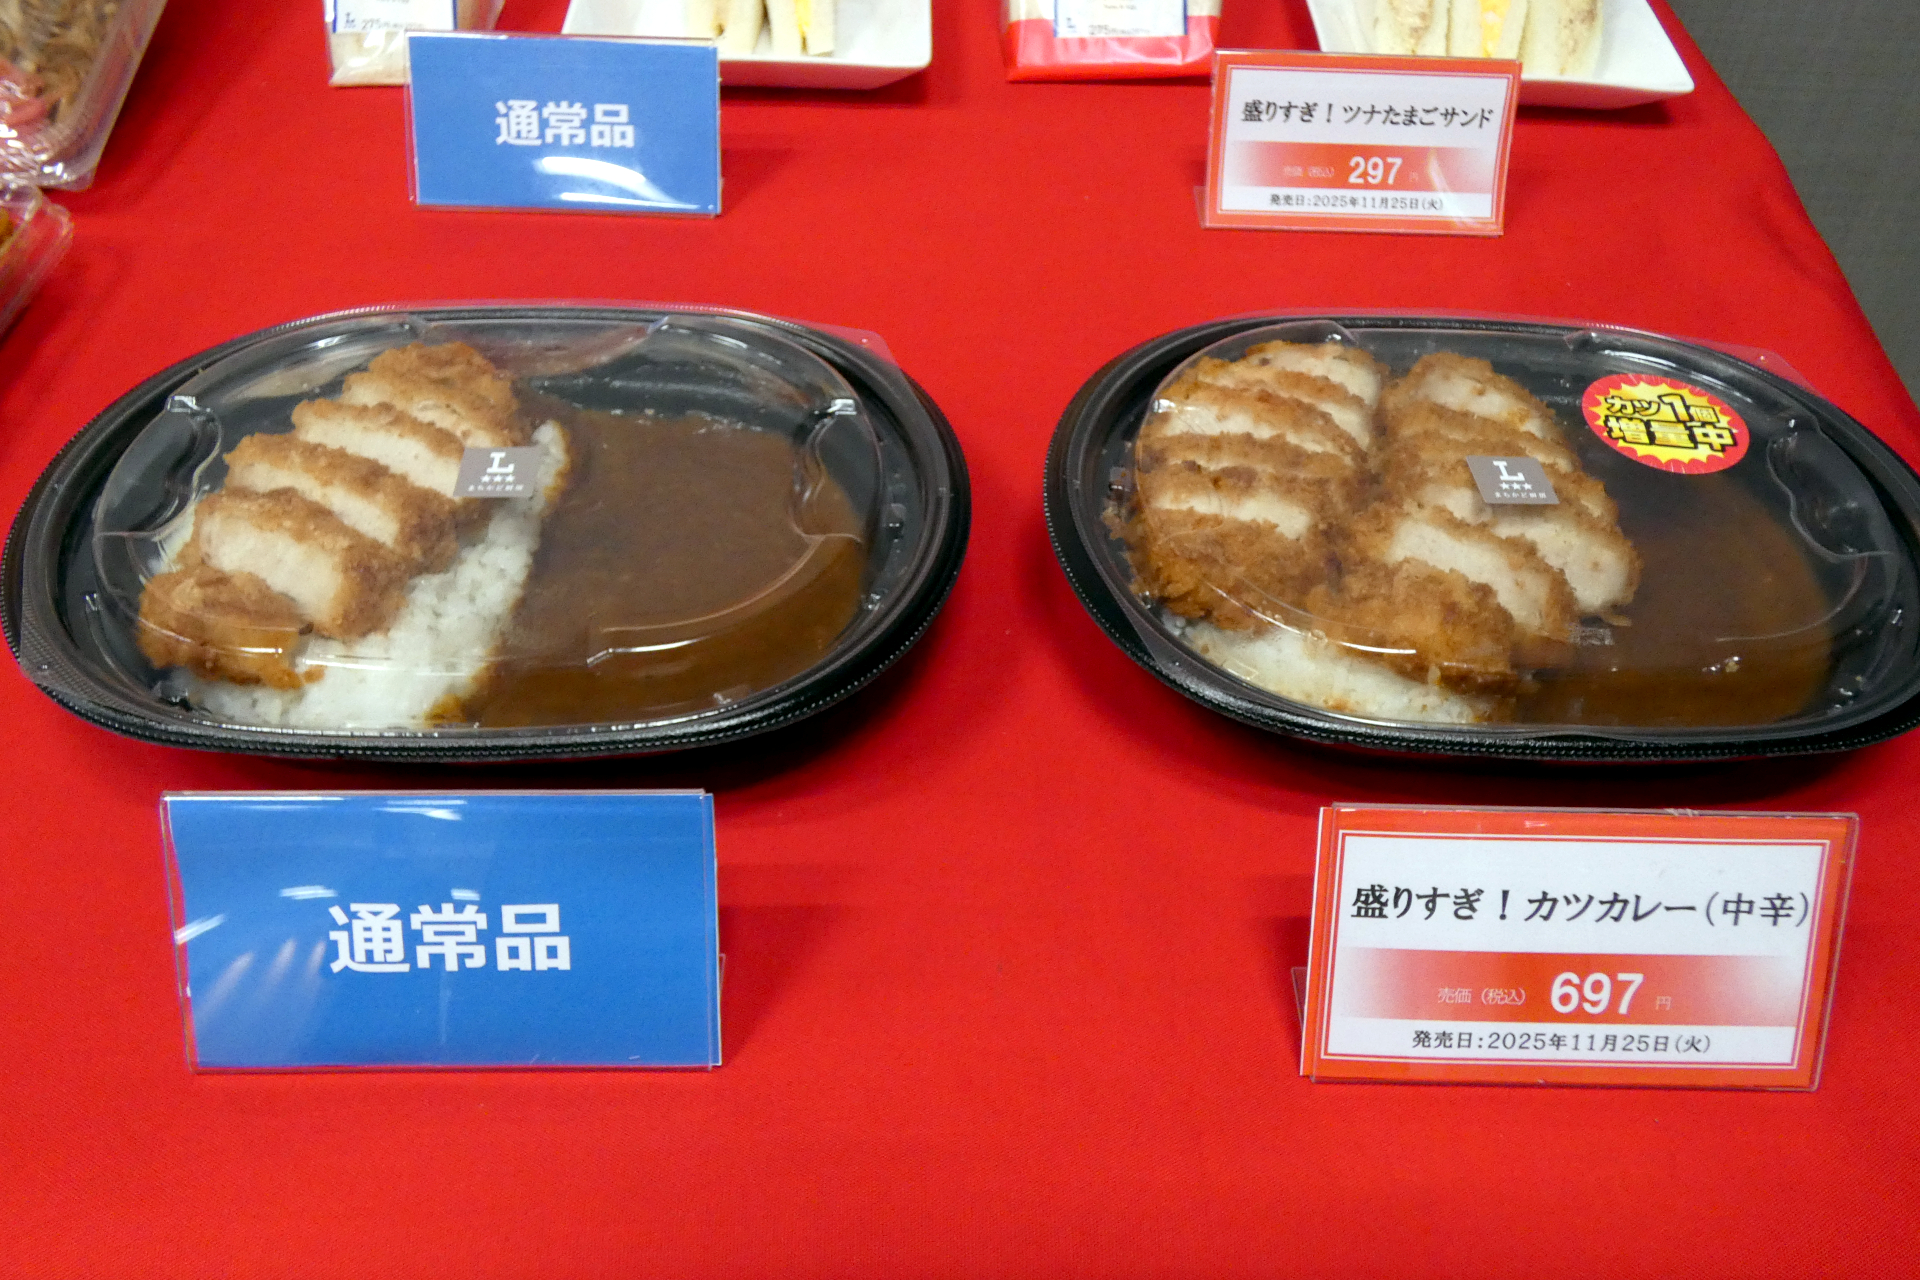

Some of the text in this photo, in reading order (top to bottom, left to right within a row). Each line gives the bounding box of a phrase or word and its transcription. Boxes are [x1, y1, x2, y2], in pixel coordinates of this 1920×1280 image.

[495, 99, 636, 149] 通常品
[1347, 155, 1403, 185] 297
[1605, 393, 1721, 424] カツ1個
[1604, 415, 1738, 452] 増量中
[486, 451, 516, 474] L
[1492, 460, 1526, 482] L
[328, 902, 571, 974] 通常品
[1549, 971, 1645, 1016] 697
[1655, 995, 1673, 1011] 円
[1411, 1030, 1712, 1054] 発売日:2025年11月25日(火)
